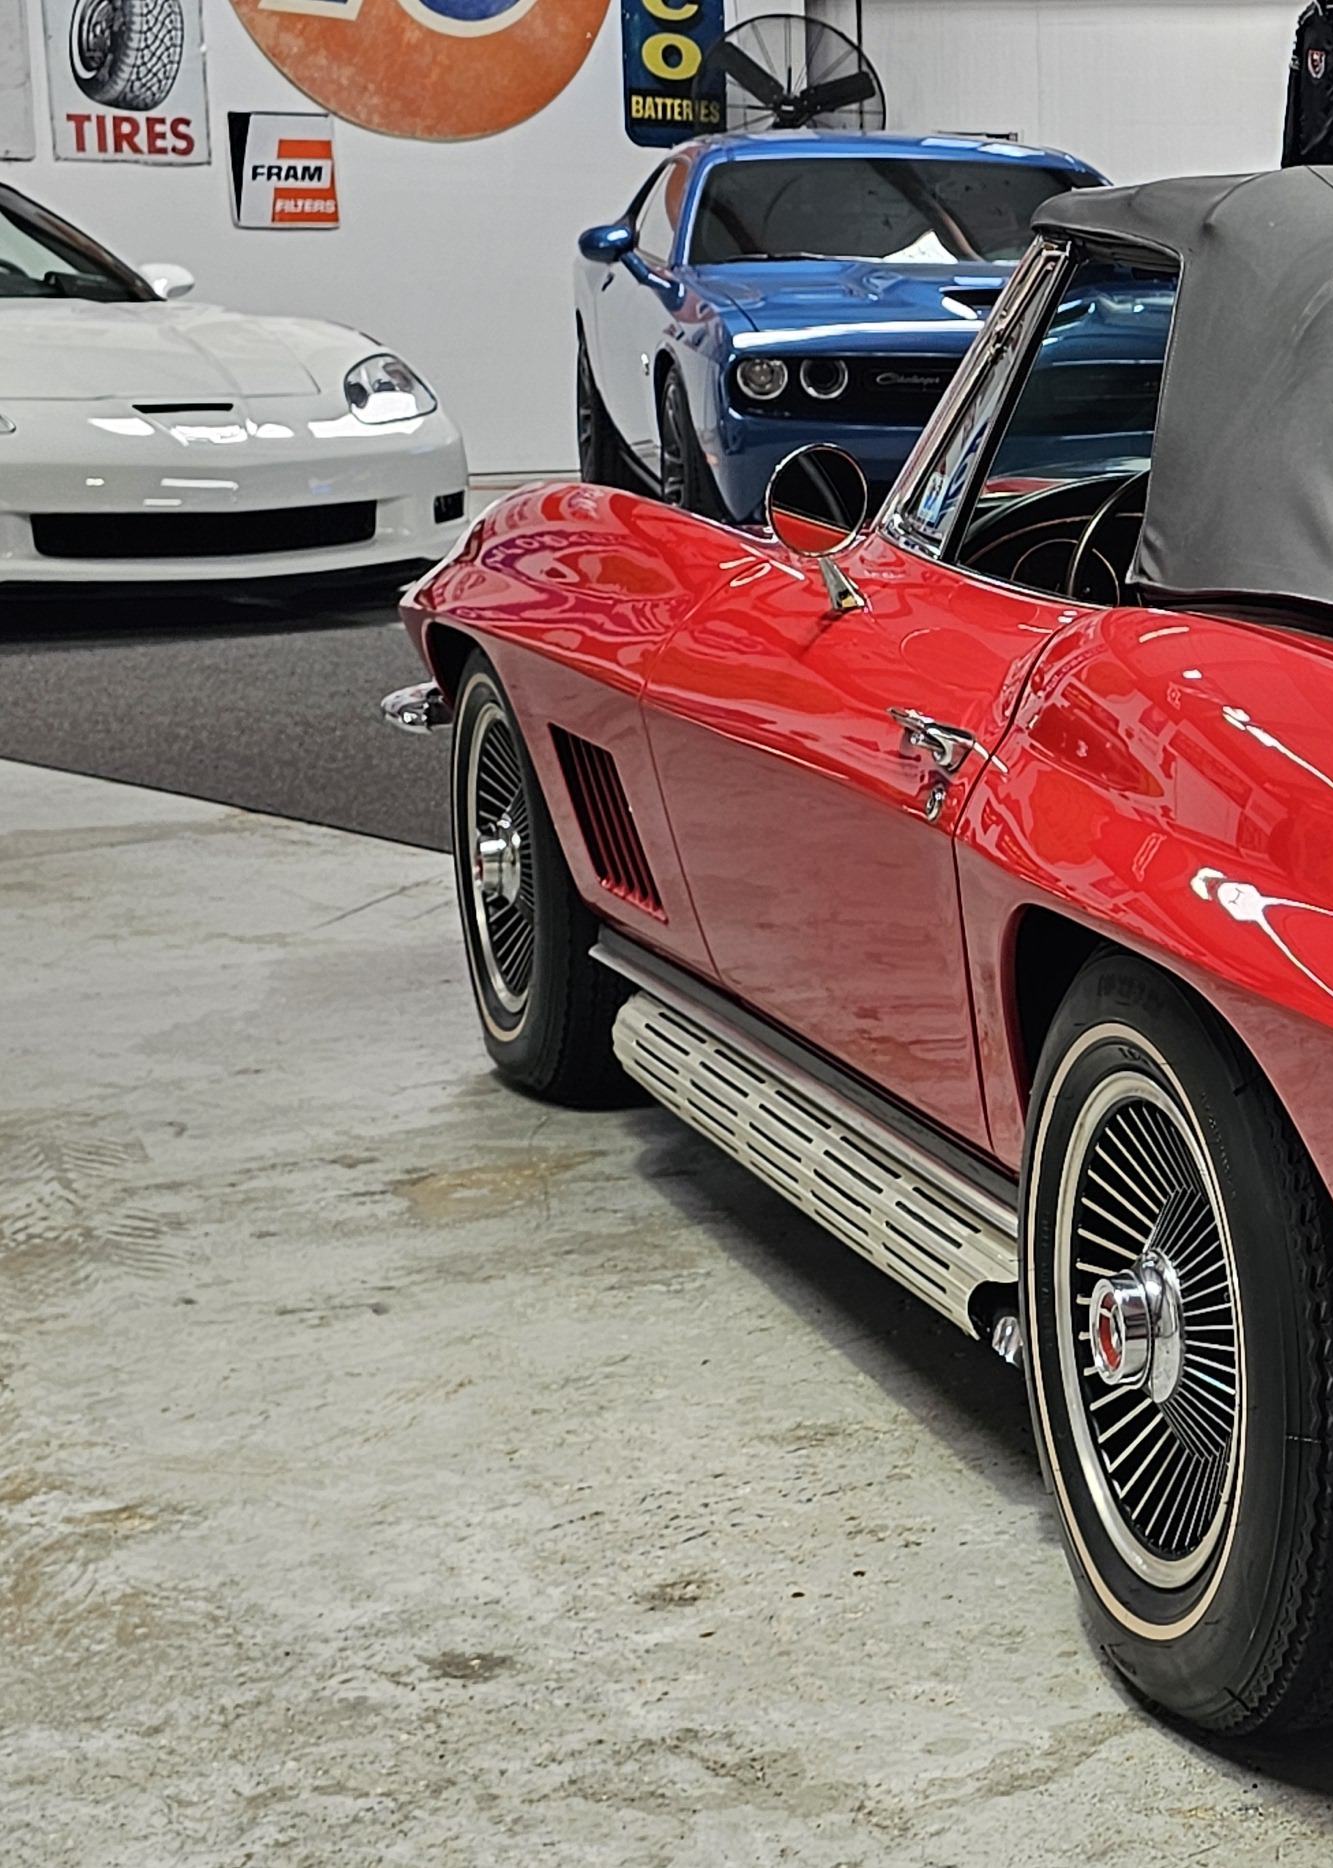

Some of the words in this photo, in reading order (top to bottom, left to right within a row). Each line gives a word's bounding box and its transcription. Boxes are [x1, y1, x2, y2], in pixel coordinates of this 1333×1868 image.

[66, 113, 195, 156] TIRES
[251, 164, 323, 182] FRAM
[275, 198, 336, 214] FILTERS
